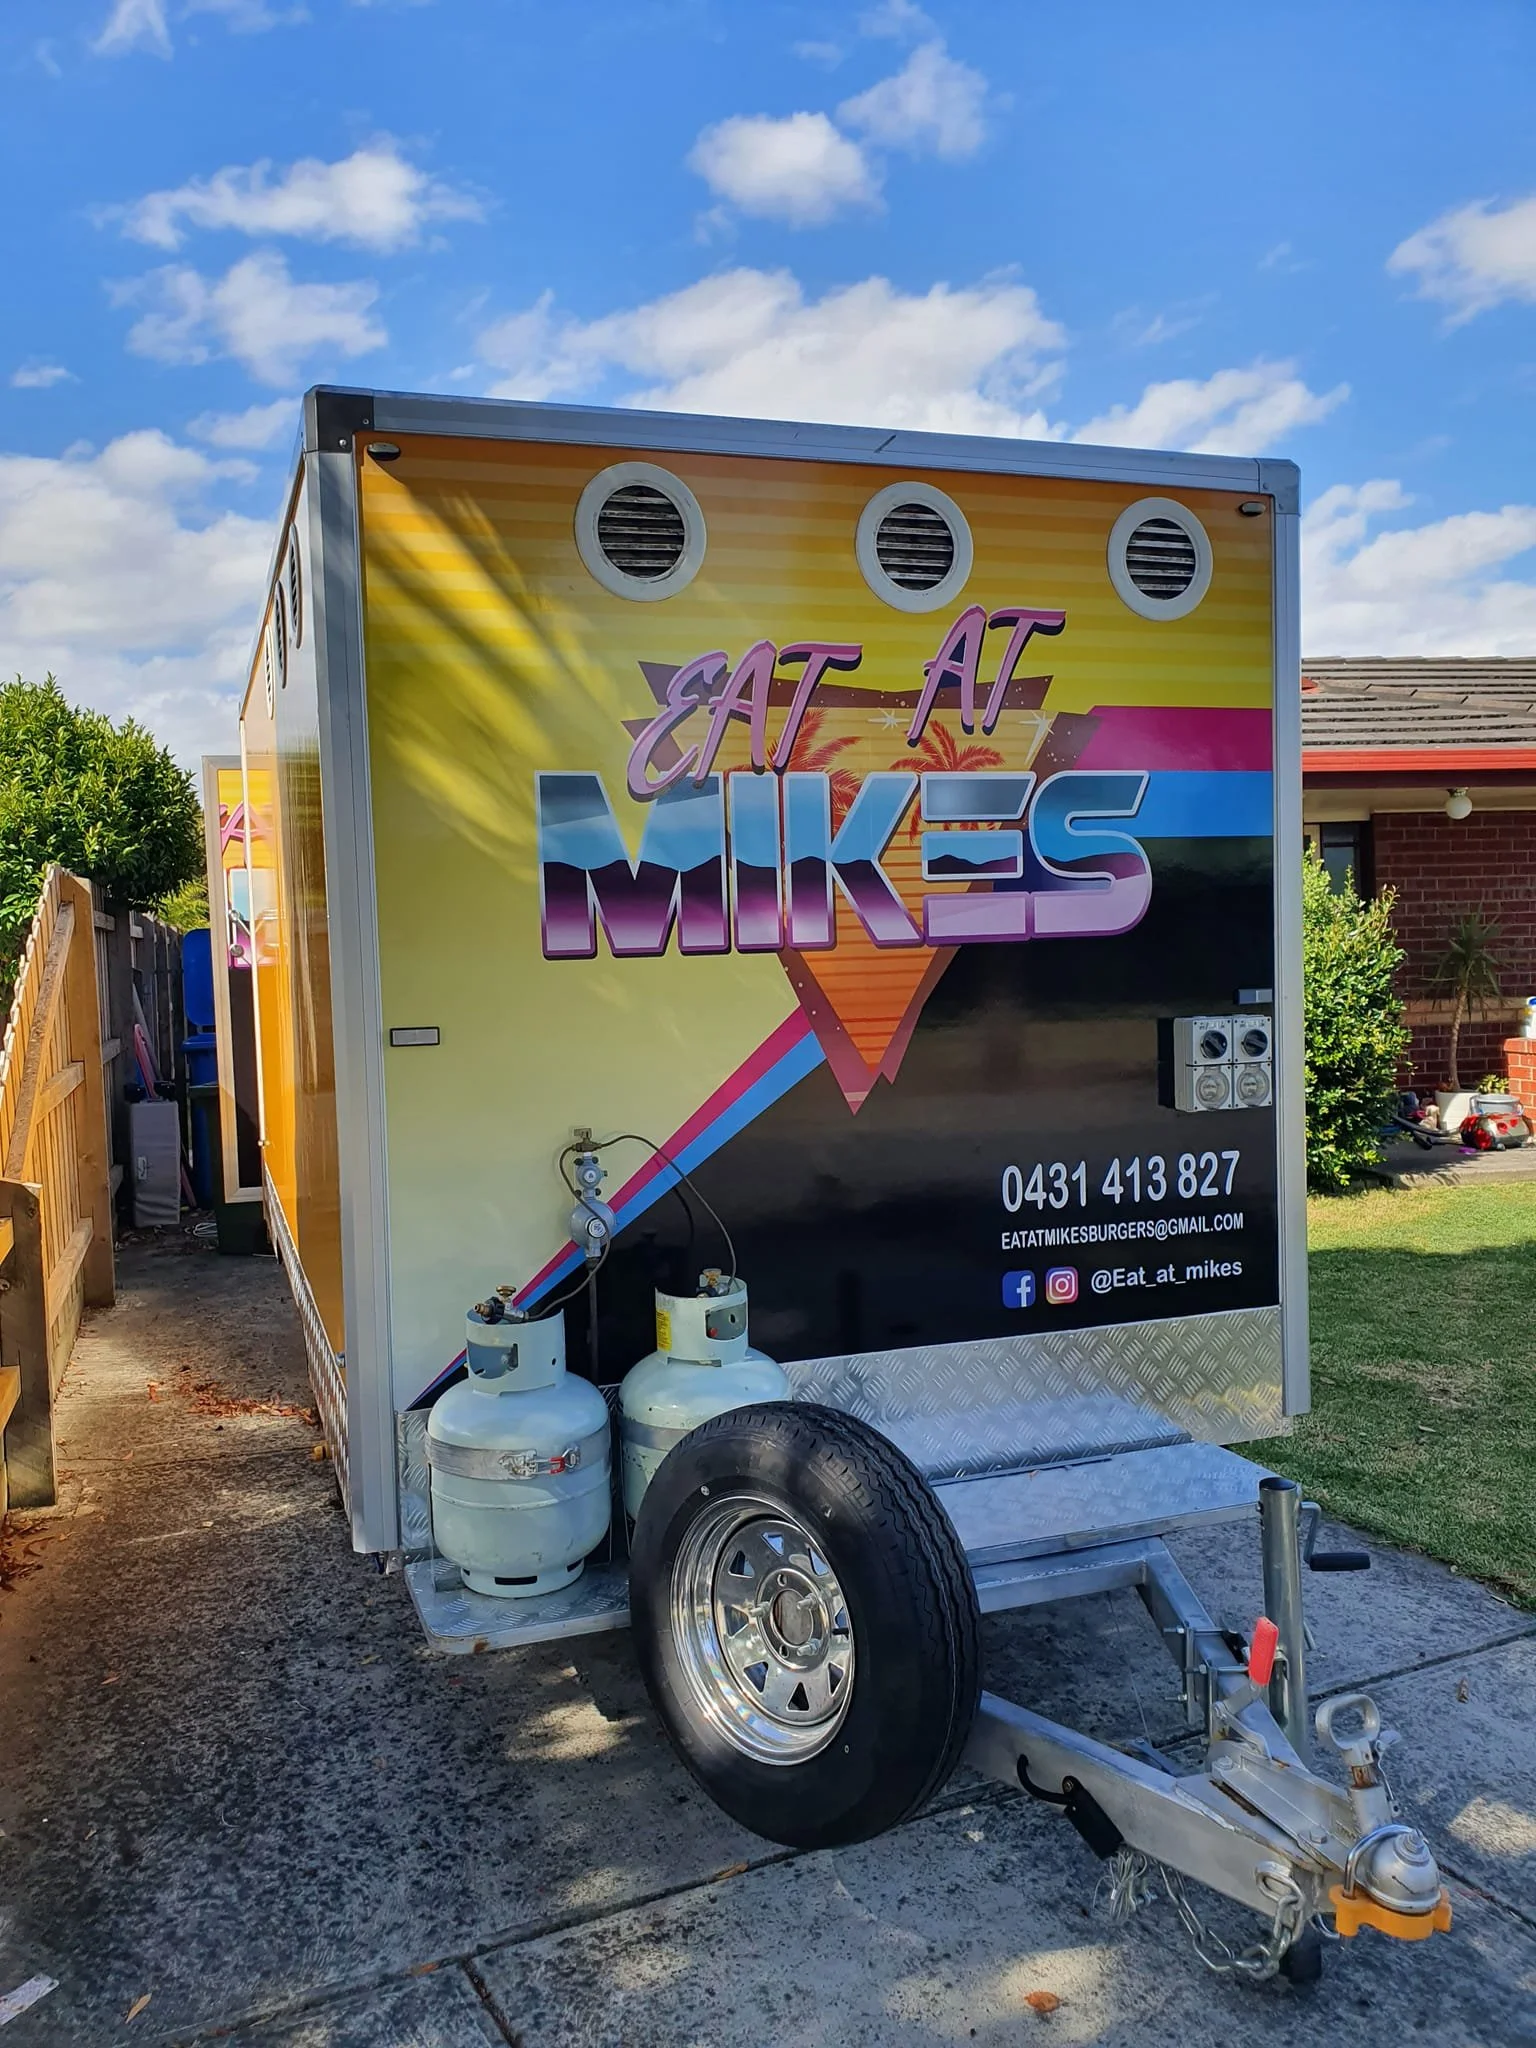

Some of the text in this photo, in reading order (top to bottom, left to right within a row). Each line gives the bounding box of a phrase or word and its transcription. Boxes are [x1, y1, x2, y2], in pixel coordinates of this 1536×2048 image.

[627, 604, 1067, 801] EAT AT
[534, 769, 1153, 958] MIKES
[1002, 1150, 1240, 1212] 0431 413 827
[1001, 1213, 1244, 1250] EATATMIKESBURGERS@GMAIL.COM
[1091, 1259, 1243, 1294] @Eat_at_mikes
